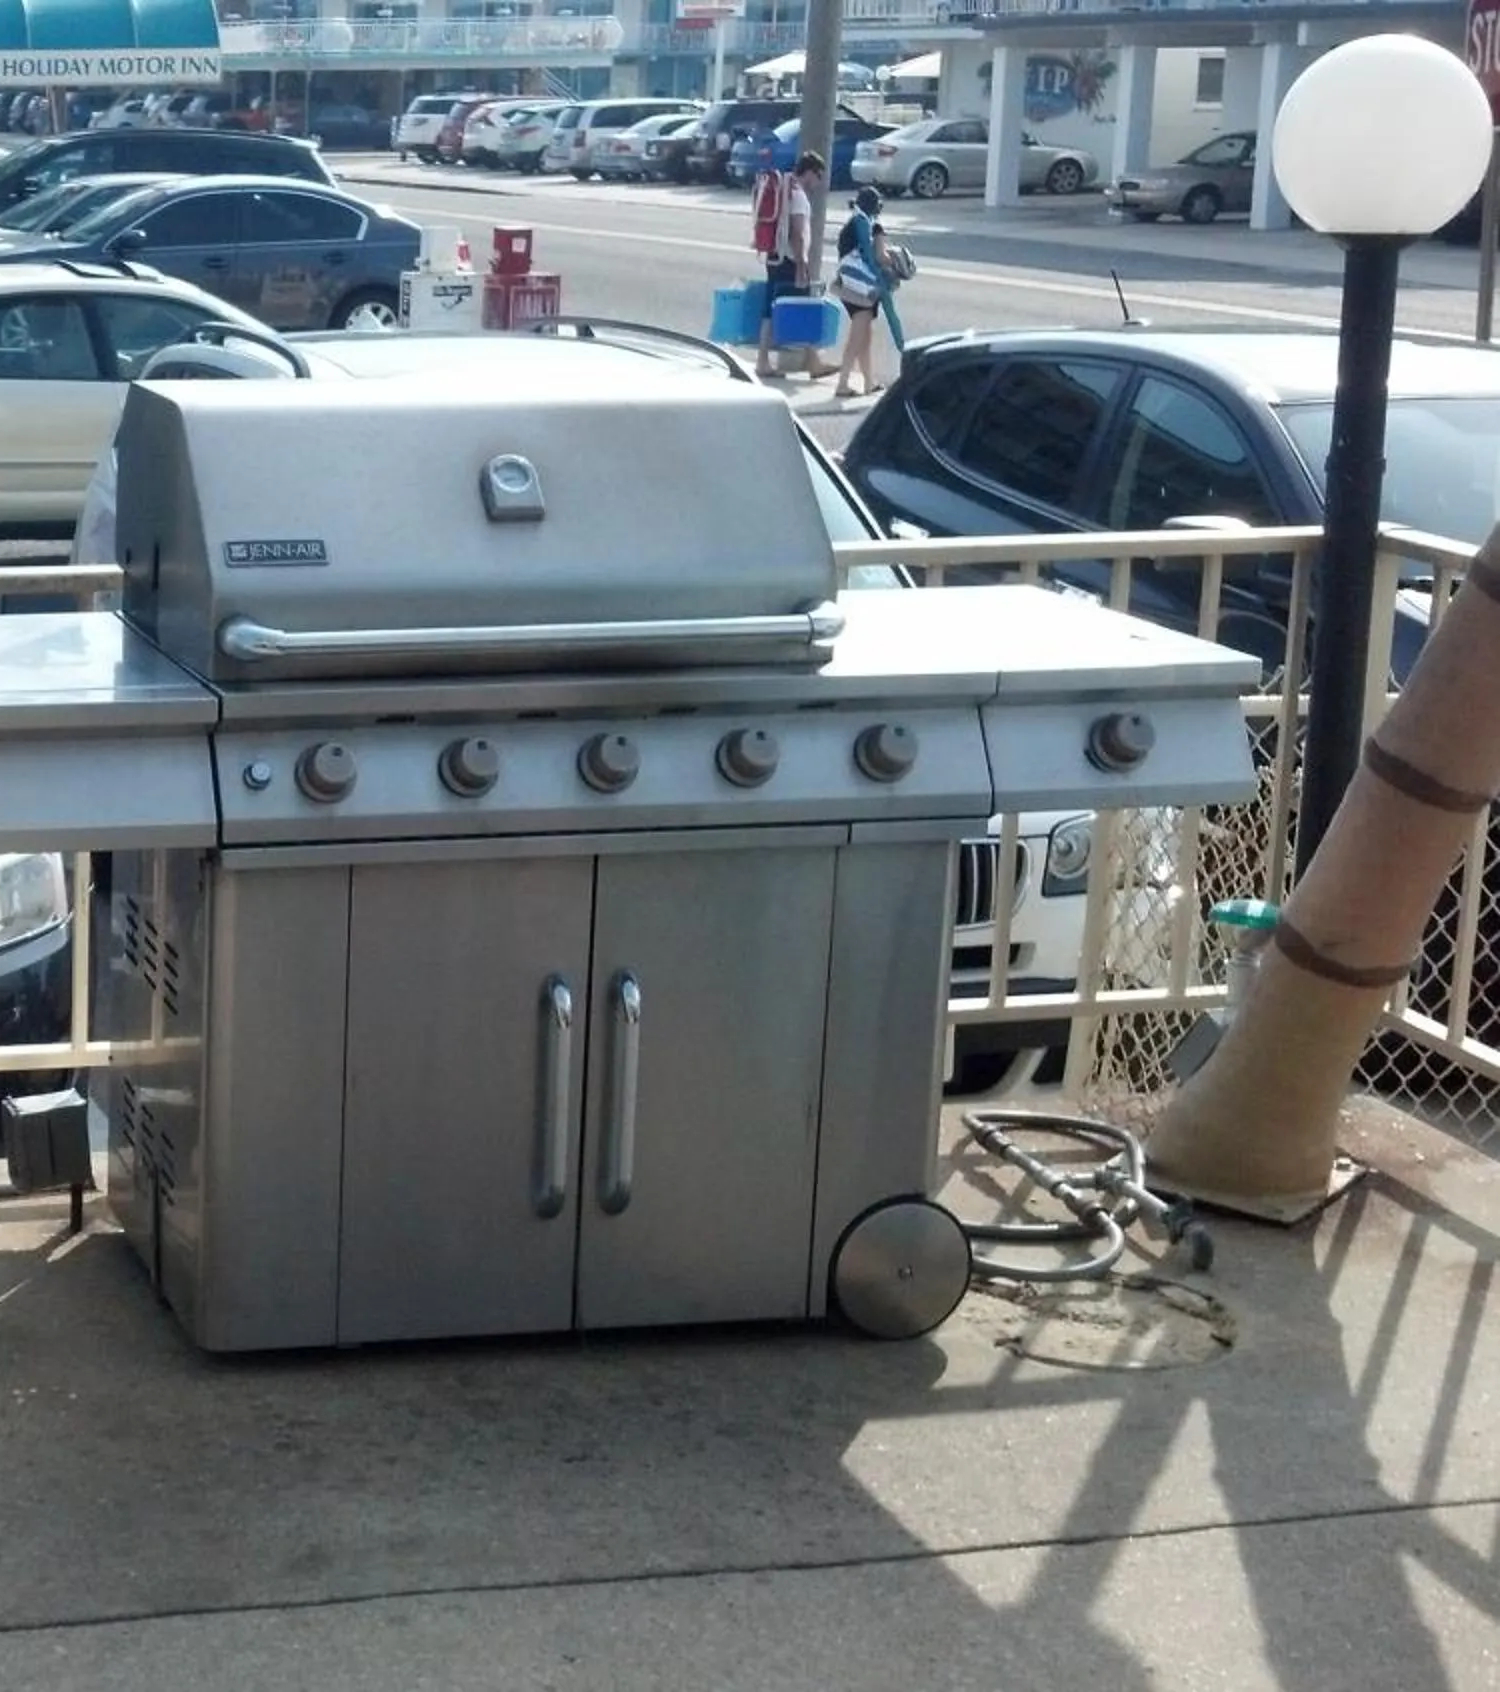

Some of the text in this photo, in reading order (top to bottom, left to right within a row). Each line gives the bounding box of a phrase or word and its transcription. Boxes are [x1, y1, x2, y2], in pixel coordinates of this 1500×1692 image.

[3, 57, 92, 76] HOLIDAY
[98, 56, 176, 75] MOTOR
[181, 55, 217, 75] INN
[248, 542, 322, 561] JENN-AIR
